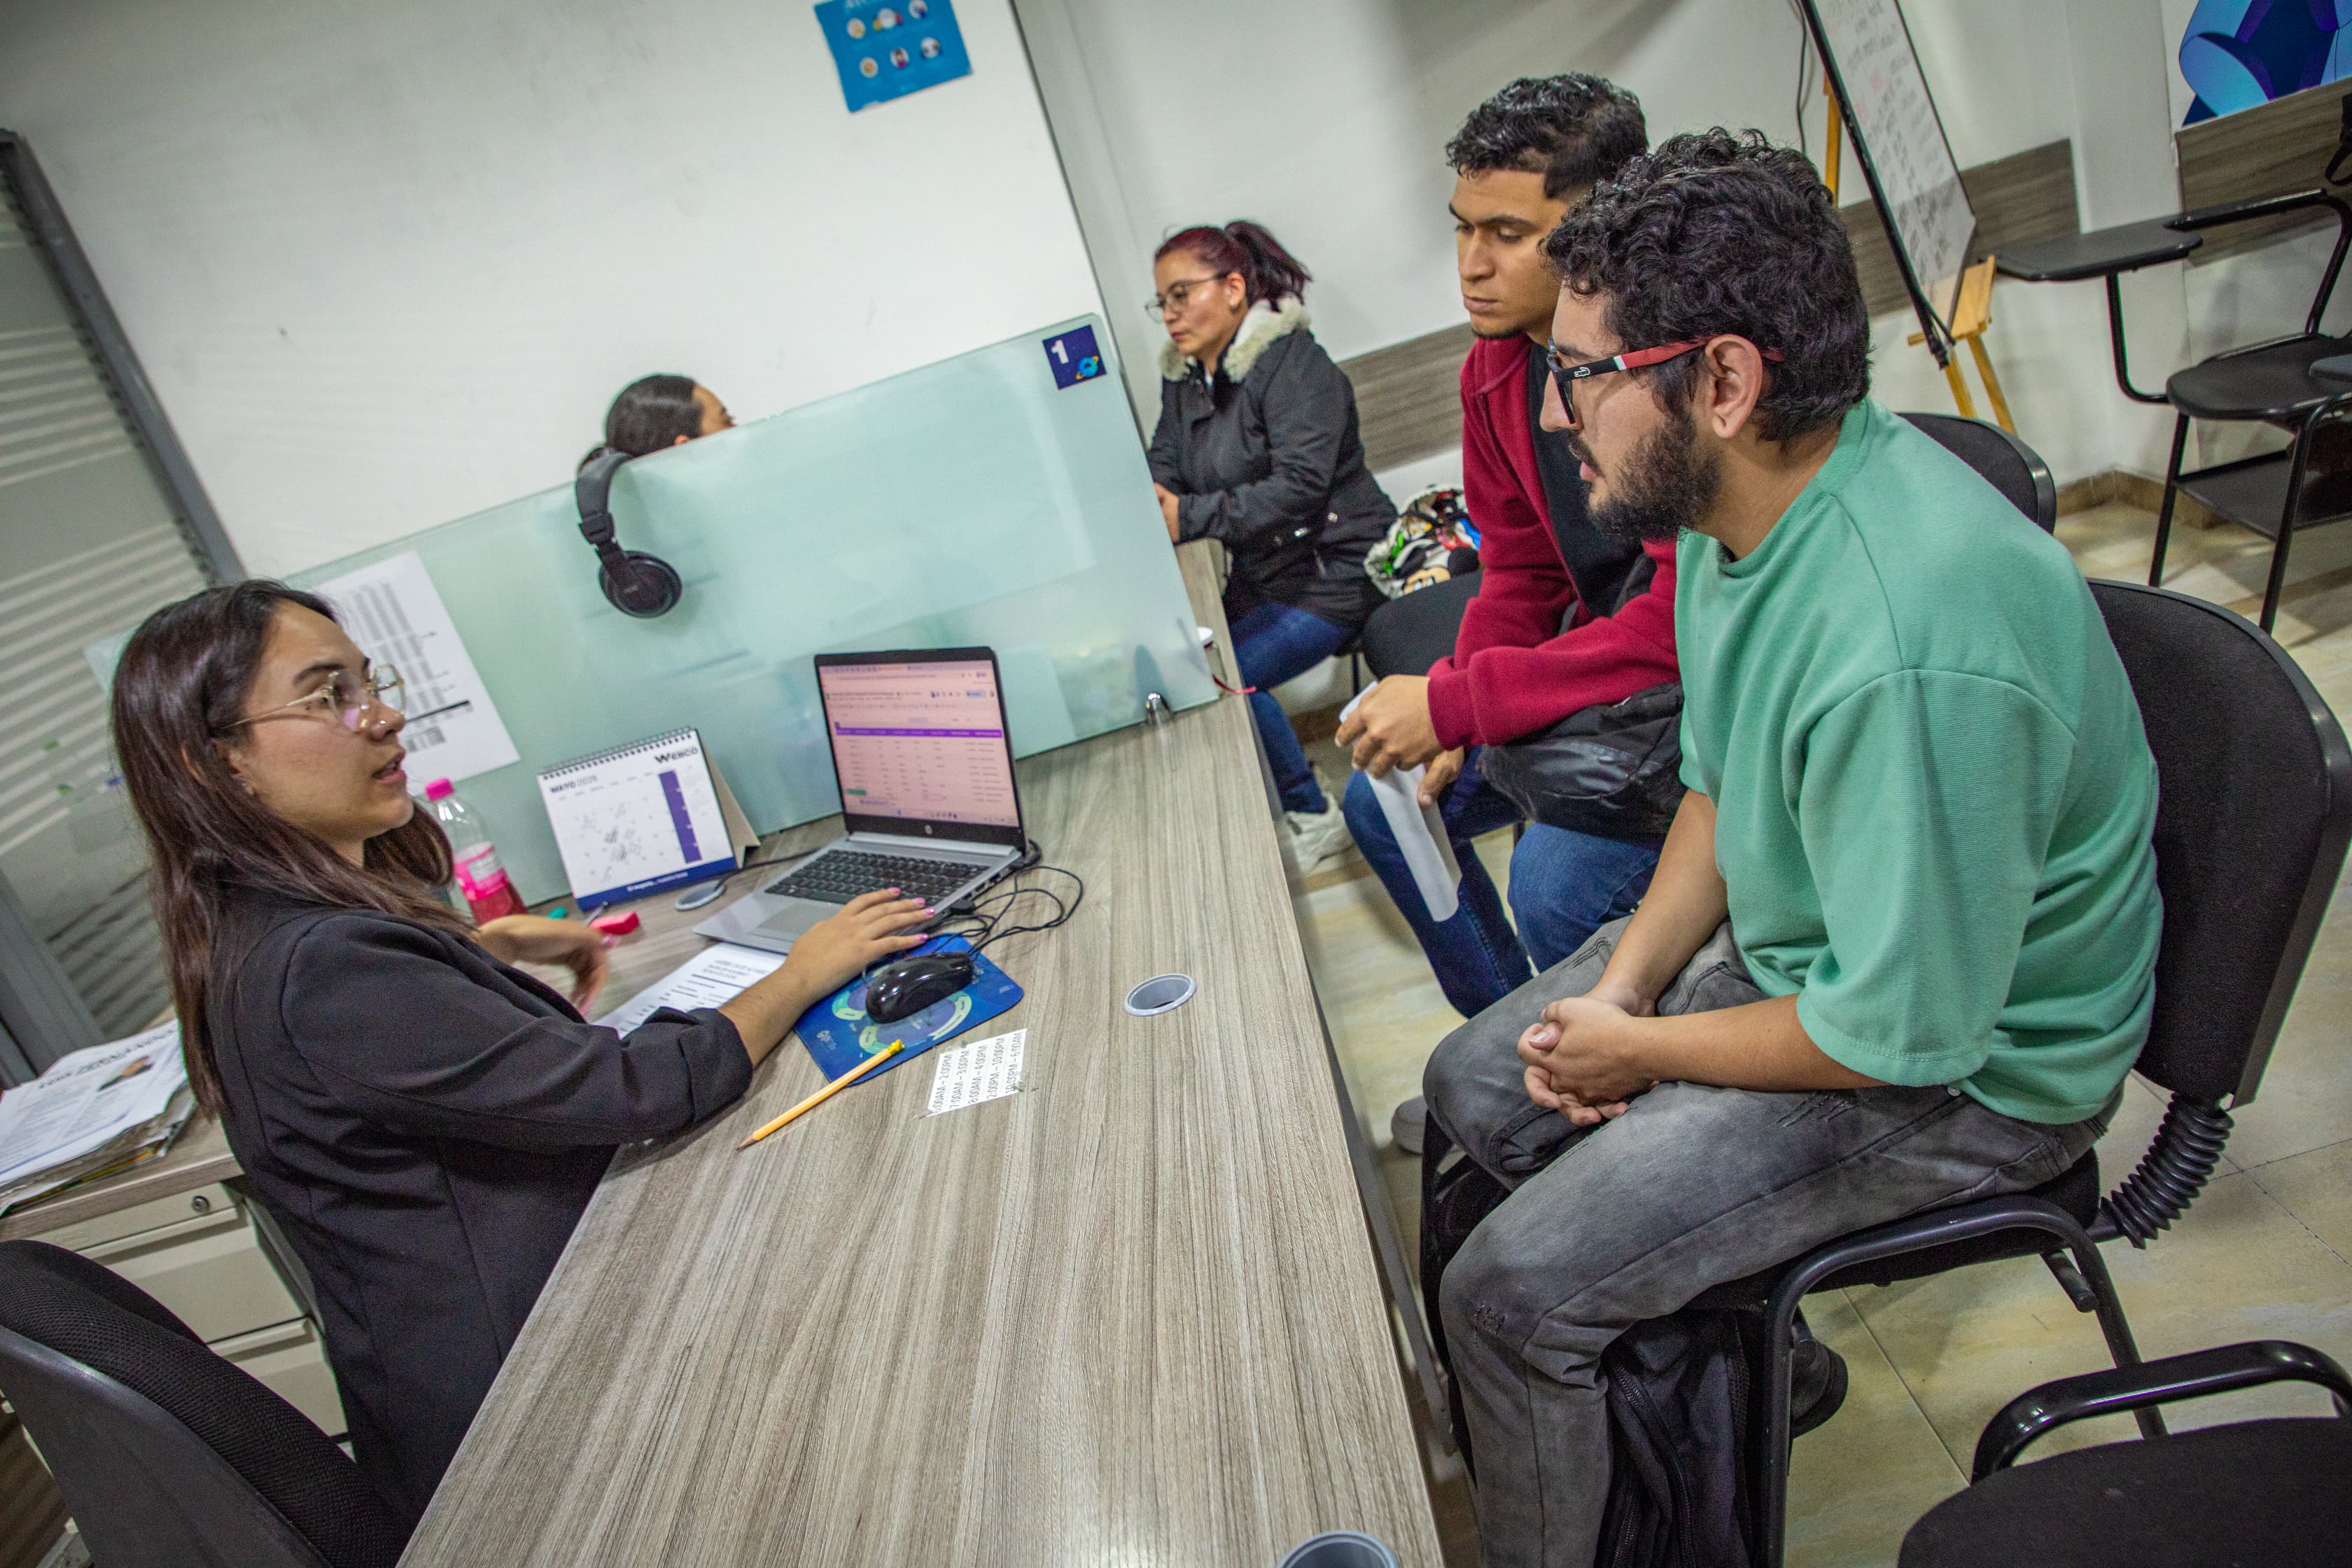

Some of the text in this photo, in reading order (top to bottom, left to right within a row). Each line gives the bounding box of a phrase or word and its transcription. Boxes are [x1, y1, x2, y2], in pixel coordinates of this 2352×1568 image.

[1051, 340, 1069, 364] 1
[974, 1045, 988, 1070] 4:00PM
[949, 1082, 964, 1110] 7:00AM
[968, 1076, 983, 1104] 8:00AM
[986, 1072, 1000, 1099] 2:00PM
